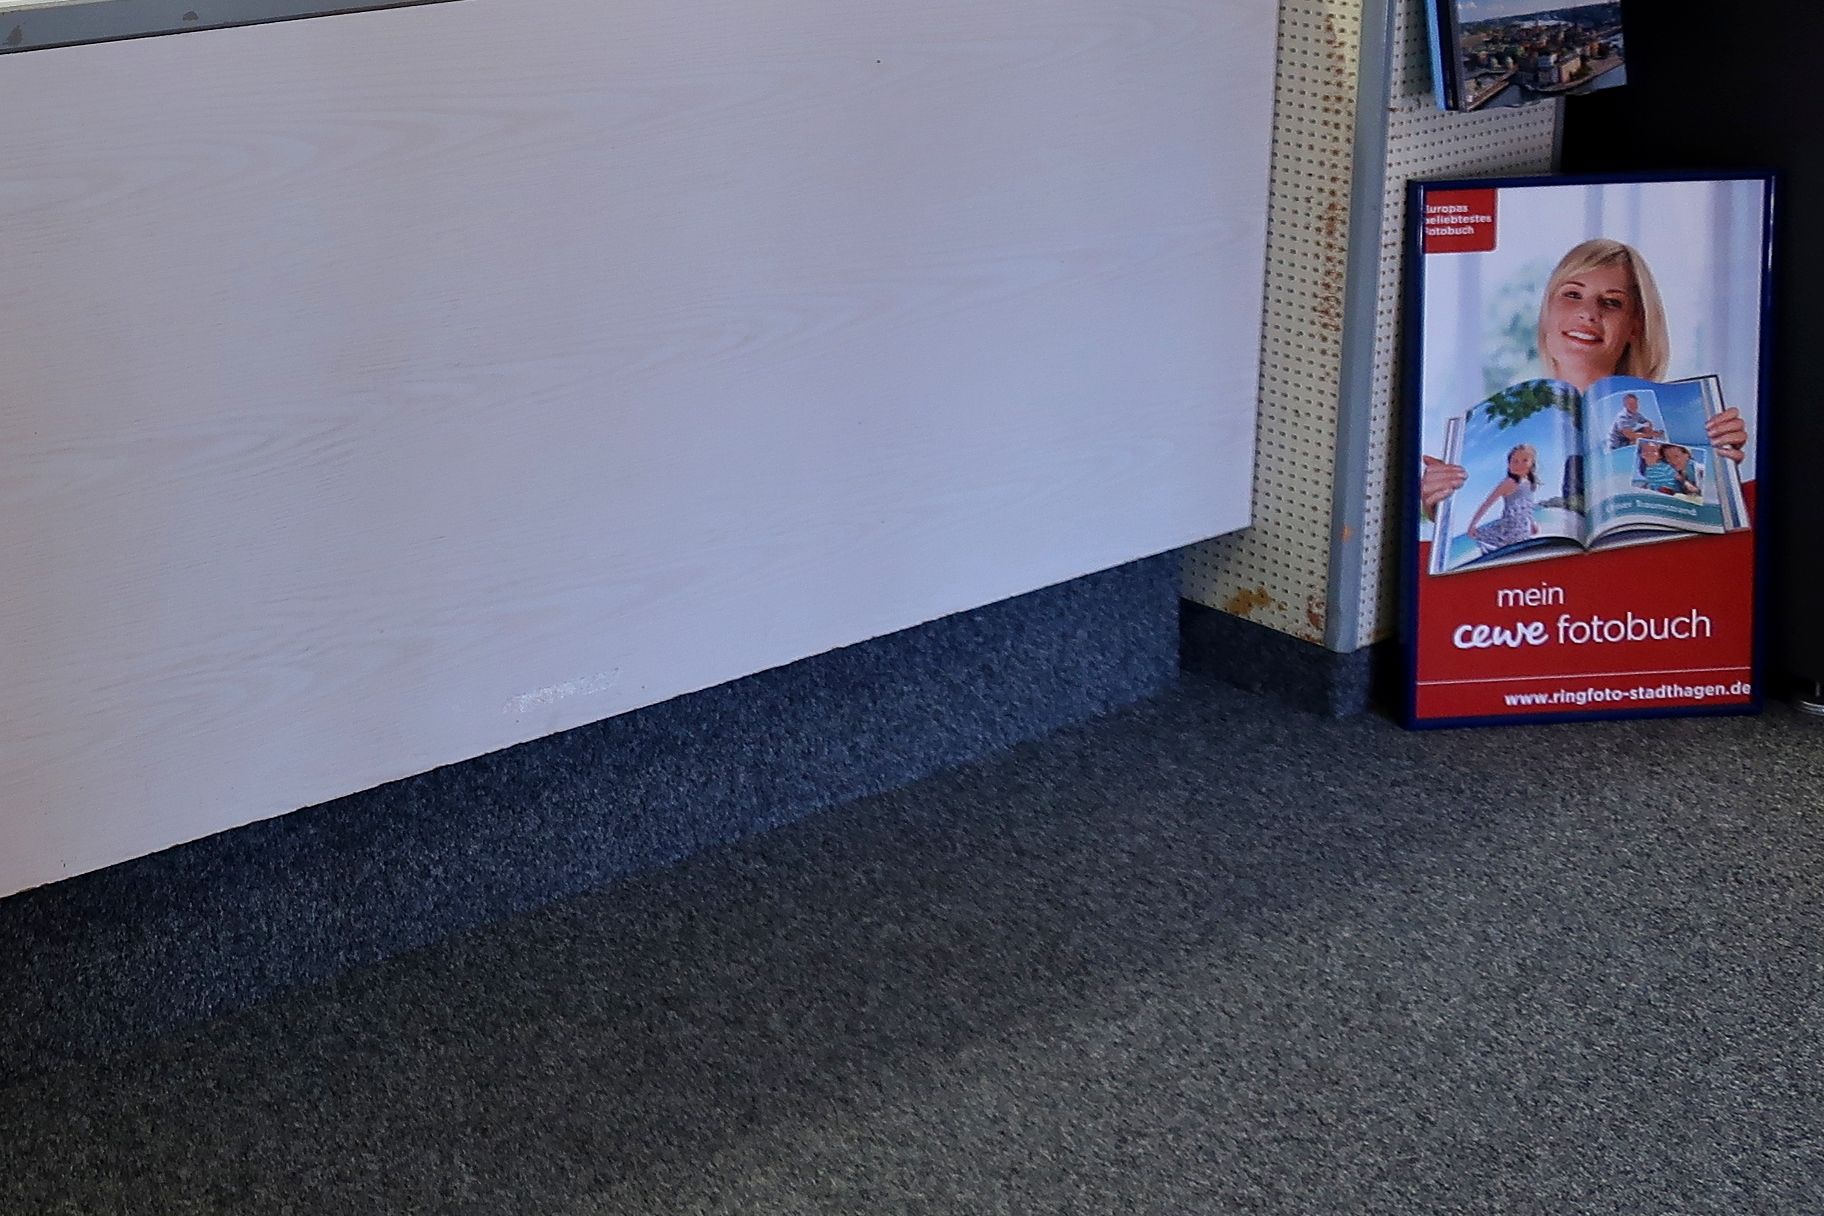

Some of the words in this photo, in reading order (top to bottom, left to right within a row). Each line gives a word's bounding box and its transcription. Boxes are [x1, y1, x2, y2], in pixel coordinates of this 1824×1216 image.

[1497, 582, 1565, 608] mein
[1452, 620, 1550, 650] cewe
[1557, 608, 1711, 644] fotobuch
[1504, 681, 1752, 706] www.ringfoto-stadthagen.de
